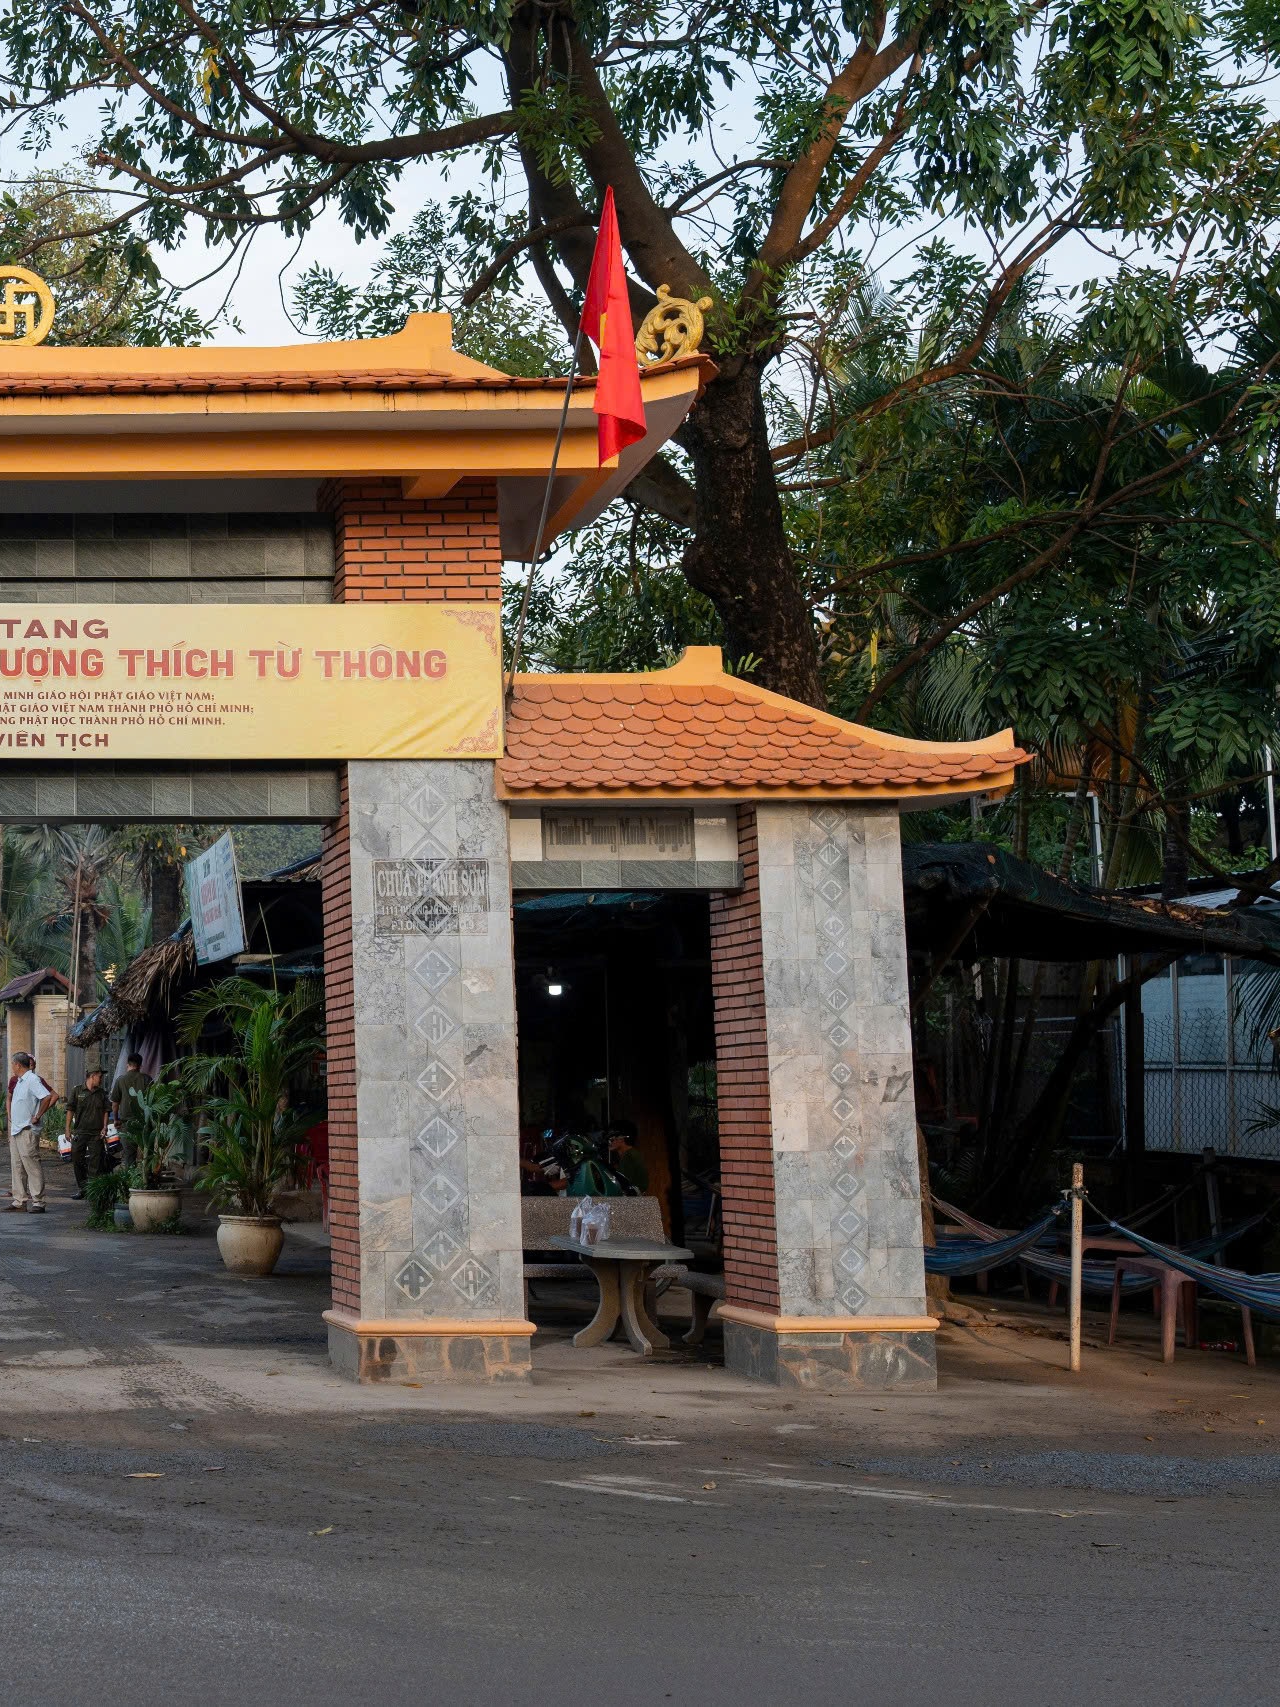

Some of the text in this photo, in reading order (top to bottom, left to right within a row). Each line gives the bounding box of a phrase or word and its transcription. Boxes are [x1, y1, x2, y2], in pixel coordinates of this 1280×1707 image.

[0, 619, 109, 639] TANG
[118, 640, 234, 677] THÍCH
[248, 640, 303, 678] TỪ
[315, 644, 447, 679] THÔNG
[3, 691, 34, 700] MINH
[37, 689, 66, 700] GIÁO
[70, 689, 91, 702] HỘI
[94, 690, 123, 703] PHẬT
[126, 689, 155, 701] GIÁO
[158, 690, 182, 703] VIỆT
[185, 692, 215, 701] NAM;
[20, 702, 49, 713] GIÁO
[52, 703, 76, 715] VIỆT
[79, 704, 104, 713] NAM
[108, 702, 146, 713] THÀNH
[197, 703, 217, 713] CHÍ
[220, 705, 254, 714] MINH;
[20, 715, 49, 727] PHẬT
[52, 716, 76, 727] HỌC
[80, 715, 117, 725] THÀNH
[169, 715, 188, 725] CHÍ
[192, 717, 226, 725] MINH.
[56, 733, 109, 752] TỊCH
